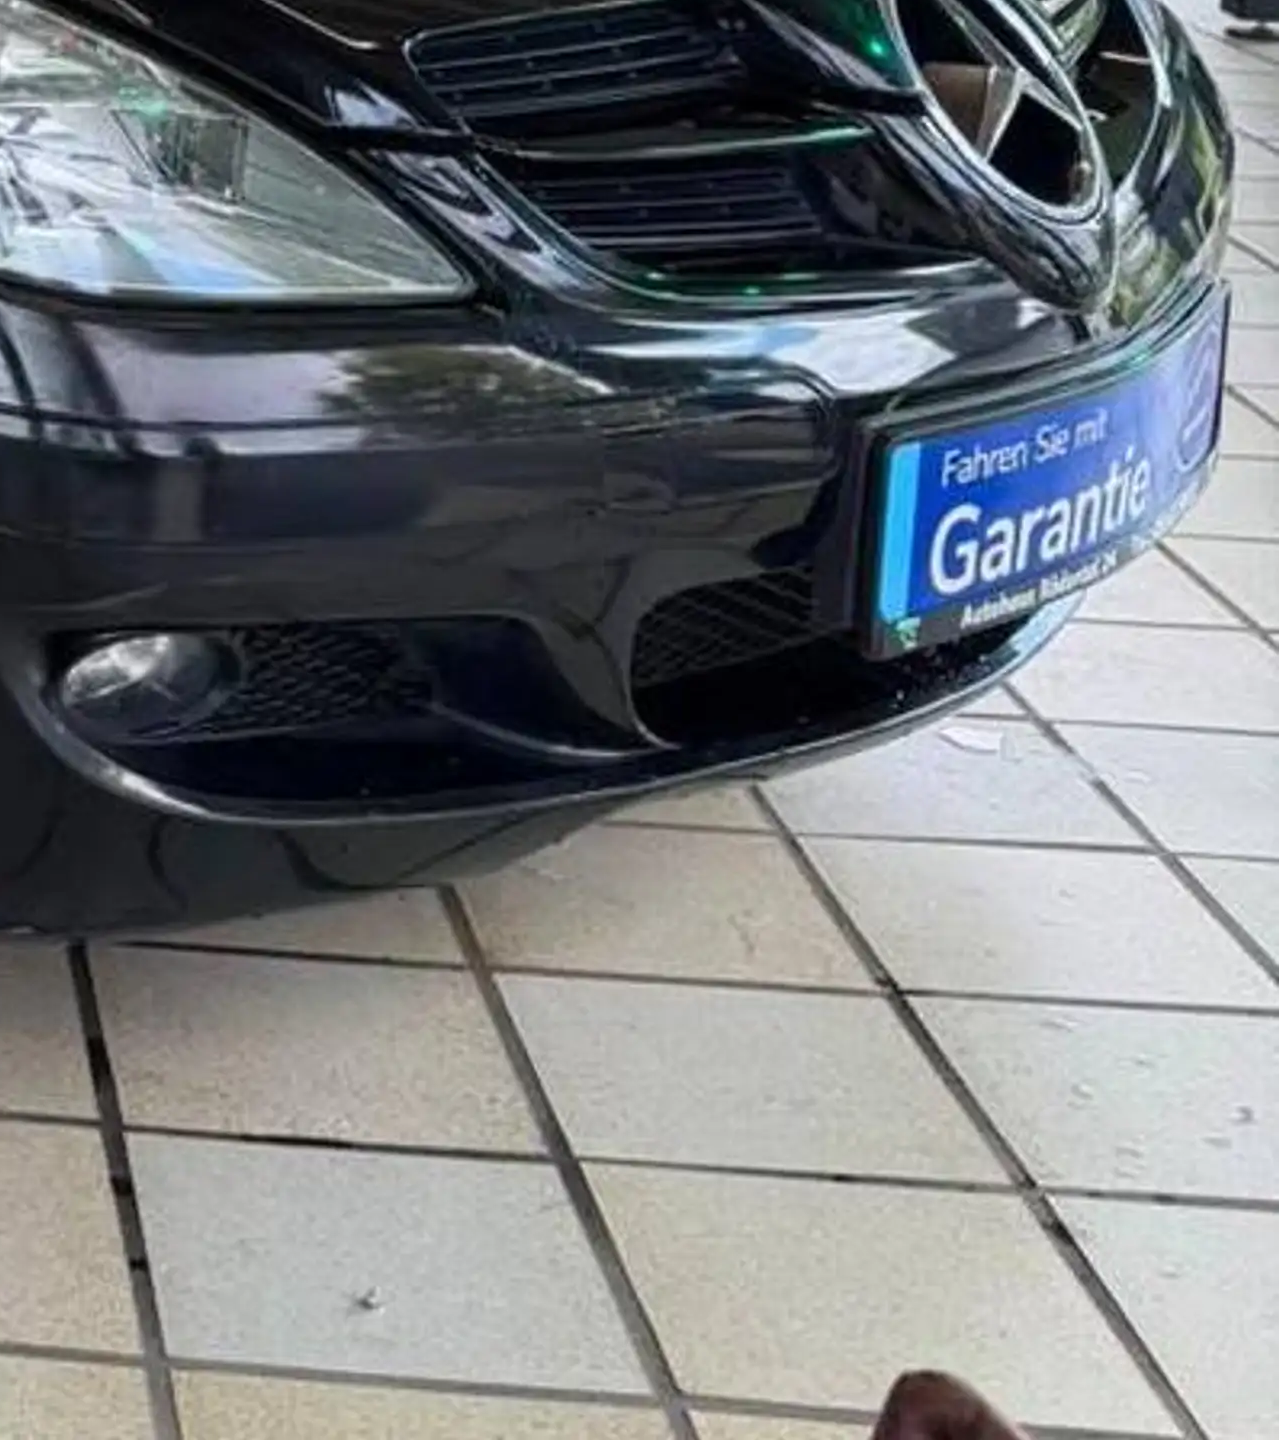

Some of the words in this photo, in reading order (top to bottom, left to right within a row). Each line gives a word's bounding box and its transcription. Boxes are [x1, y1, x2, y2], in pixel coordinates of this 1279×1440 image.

[942, 440, 1028, 487] Fahren
[1034, 422, 1070, 463] Sie
[1074, 408, 1108, 449] mit
[930, 444, 1151, 596] Garantie
